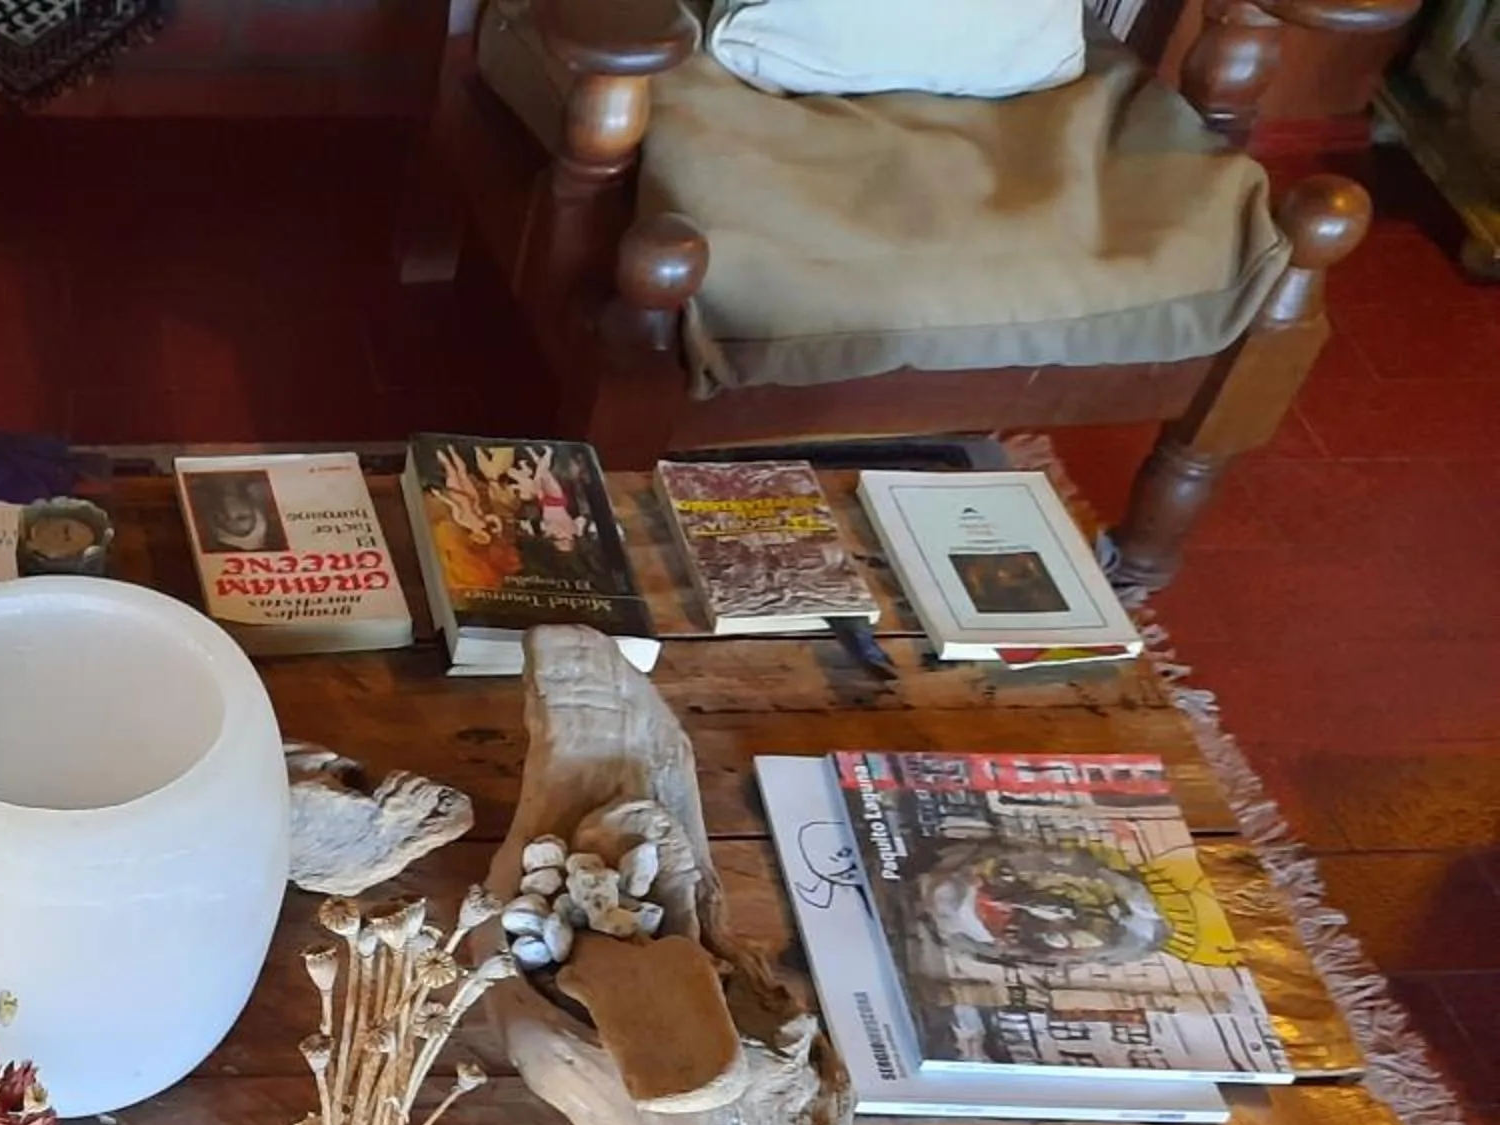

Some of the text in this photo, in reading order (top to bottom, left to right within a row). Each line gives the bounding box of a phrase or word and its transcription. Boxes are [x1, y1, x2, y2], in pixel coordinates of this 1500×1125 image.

[286, 508, 370, 524] humano
[312, 523, 374, 536] factor
[220, 551, 383, 575] GREENE
[215, 571, 390, 597] GRAHAM
[263, 605, 353, 620] grandes
[853, 765, 904, 880] Paquito Laguna
